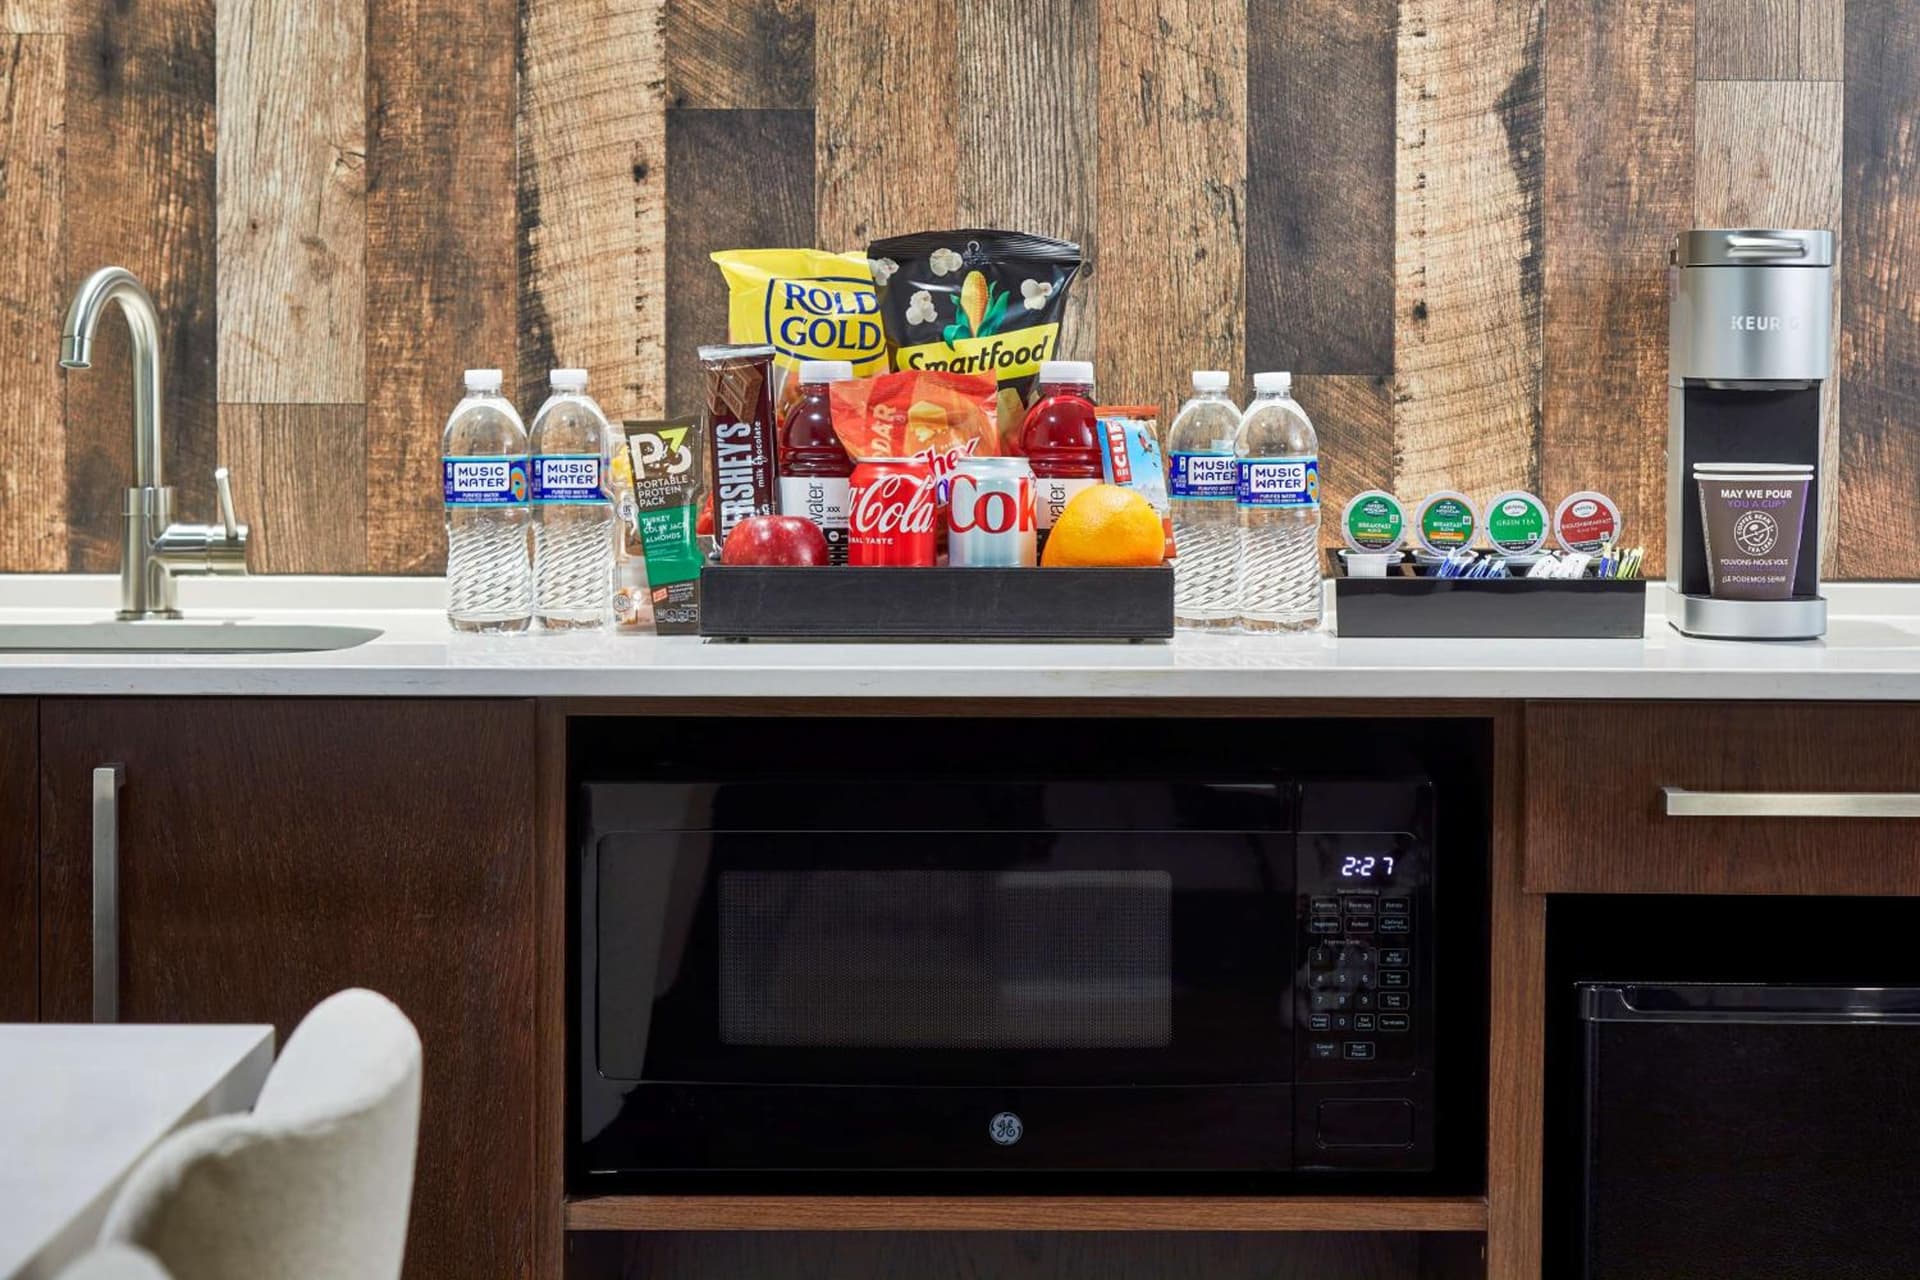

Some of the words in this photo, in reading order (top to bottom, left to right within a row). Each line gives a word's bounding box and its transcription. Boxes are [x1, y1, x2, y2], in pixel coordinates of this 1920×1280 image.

[784, 282, 880, 315] ROLD
[1731, 316, 1801, 331] KEUR
[781, 316, 881, 350] GOLD
[909, 335, 1049, 374] Smartfood
[629, 427, 692, 480] P3
[458, 466, 504, 476] MUSIC
[547, 463, 593, 474] MUSIC
[1255, 467, 1301, 477] MUSIC
[458, 478, 505, 487] WATER
[547, 474, 593, 485] WATER
[637, 474, 689, 490] PORTABLE
[716, 422, 755, 542] ERSHEY'S
[1255, 479, 1302, 488] WATER
[638, 485, 682, 499] PROTEIN
[1721, 489, 1744, 498] MAY
[1745, 489, 1763, 498] WE
[1766, 489, 1792, 499] POUR
[640, 497, 667, 508] PACK
[949, 474, 1038, 534] Cok
[670, 521, 689, 530] JAC
[866, 537, 894, 545] TASTE
[1342, 857, 1394, 876] 2:27
